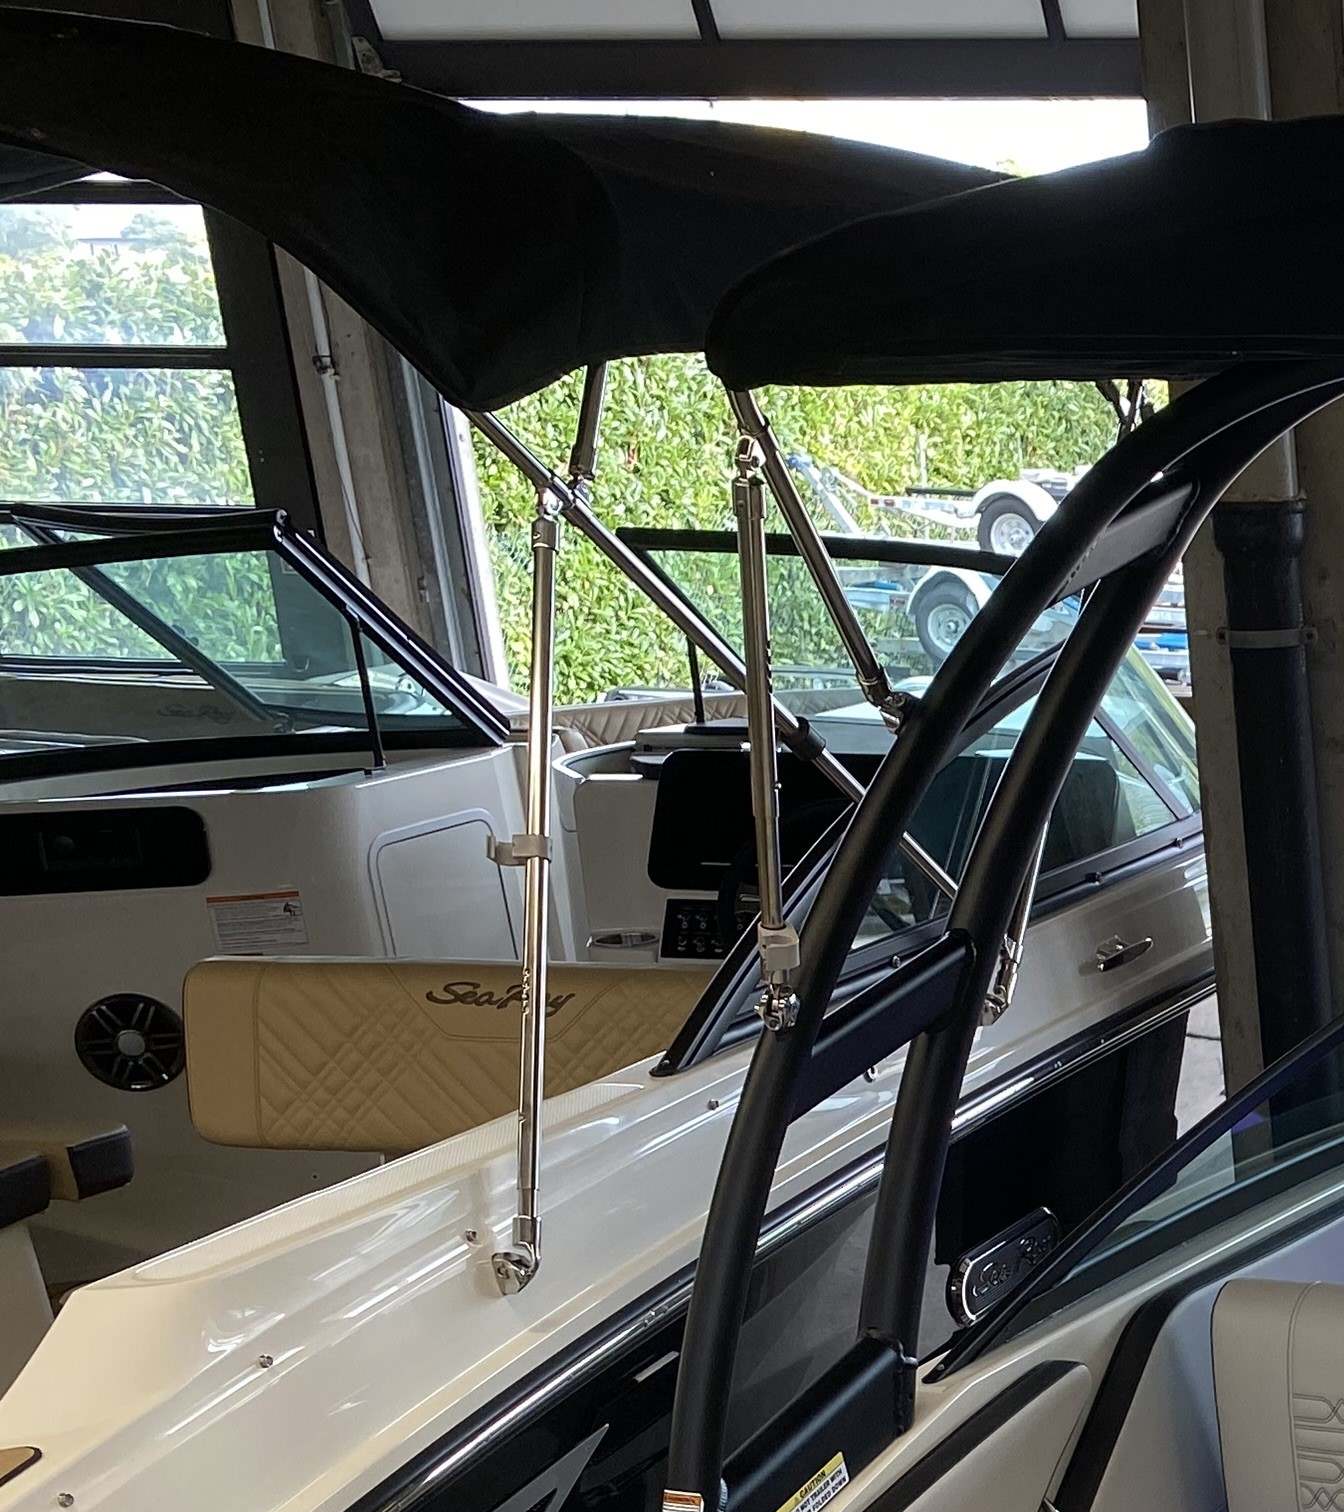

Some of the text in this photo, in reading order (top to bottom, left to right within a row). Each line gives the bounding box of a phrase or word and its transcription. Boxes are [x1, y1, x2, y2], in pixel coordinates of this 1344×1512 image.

[496, 983, 576, 1017] Ry
[800, 1470, 826, 1498] CAUTION
[810, 1480, 830, 1500] TRAILER
[812, 1490, 832, 1511] FOLDED
